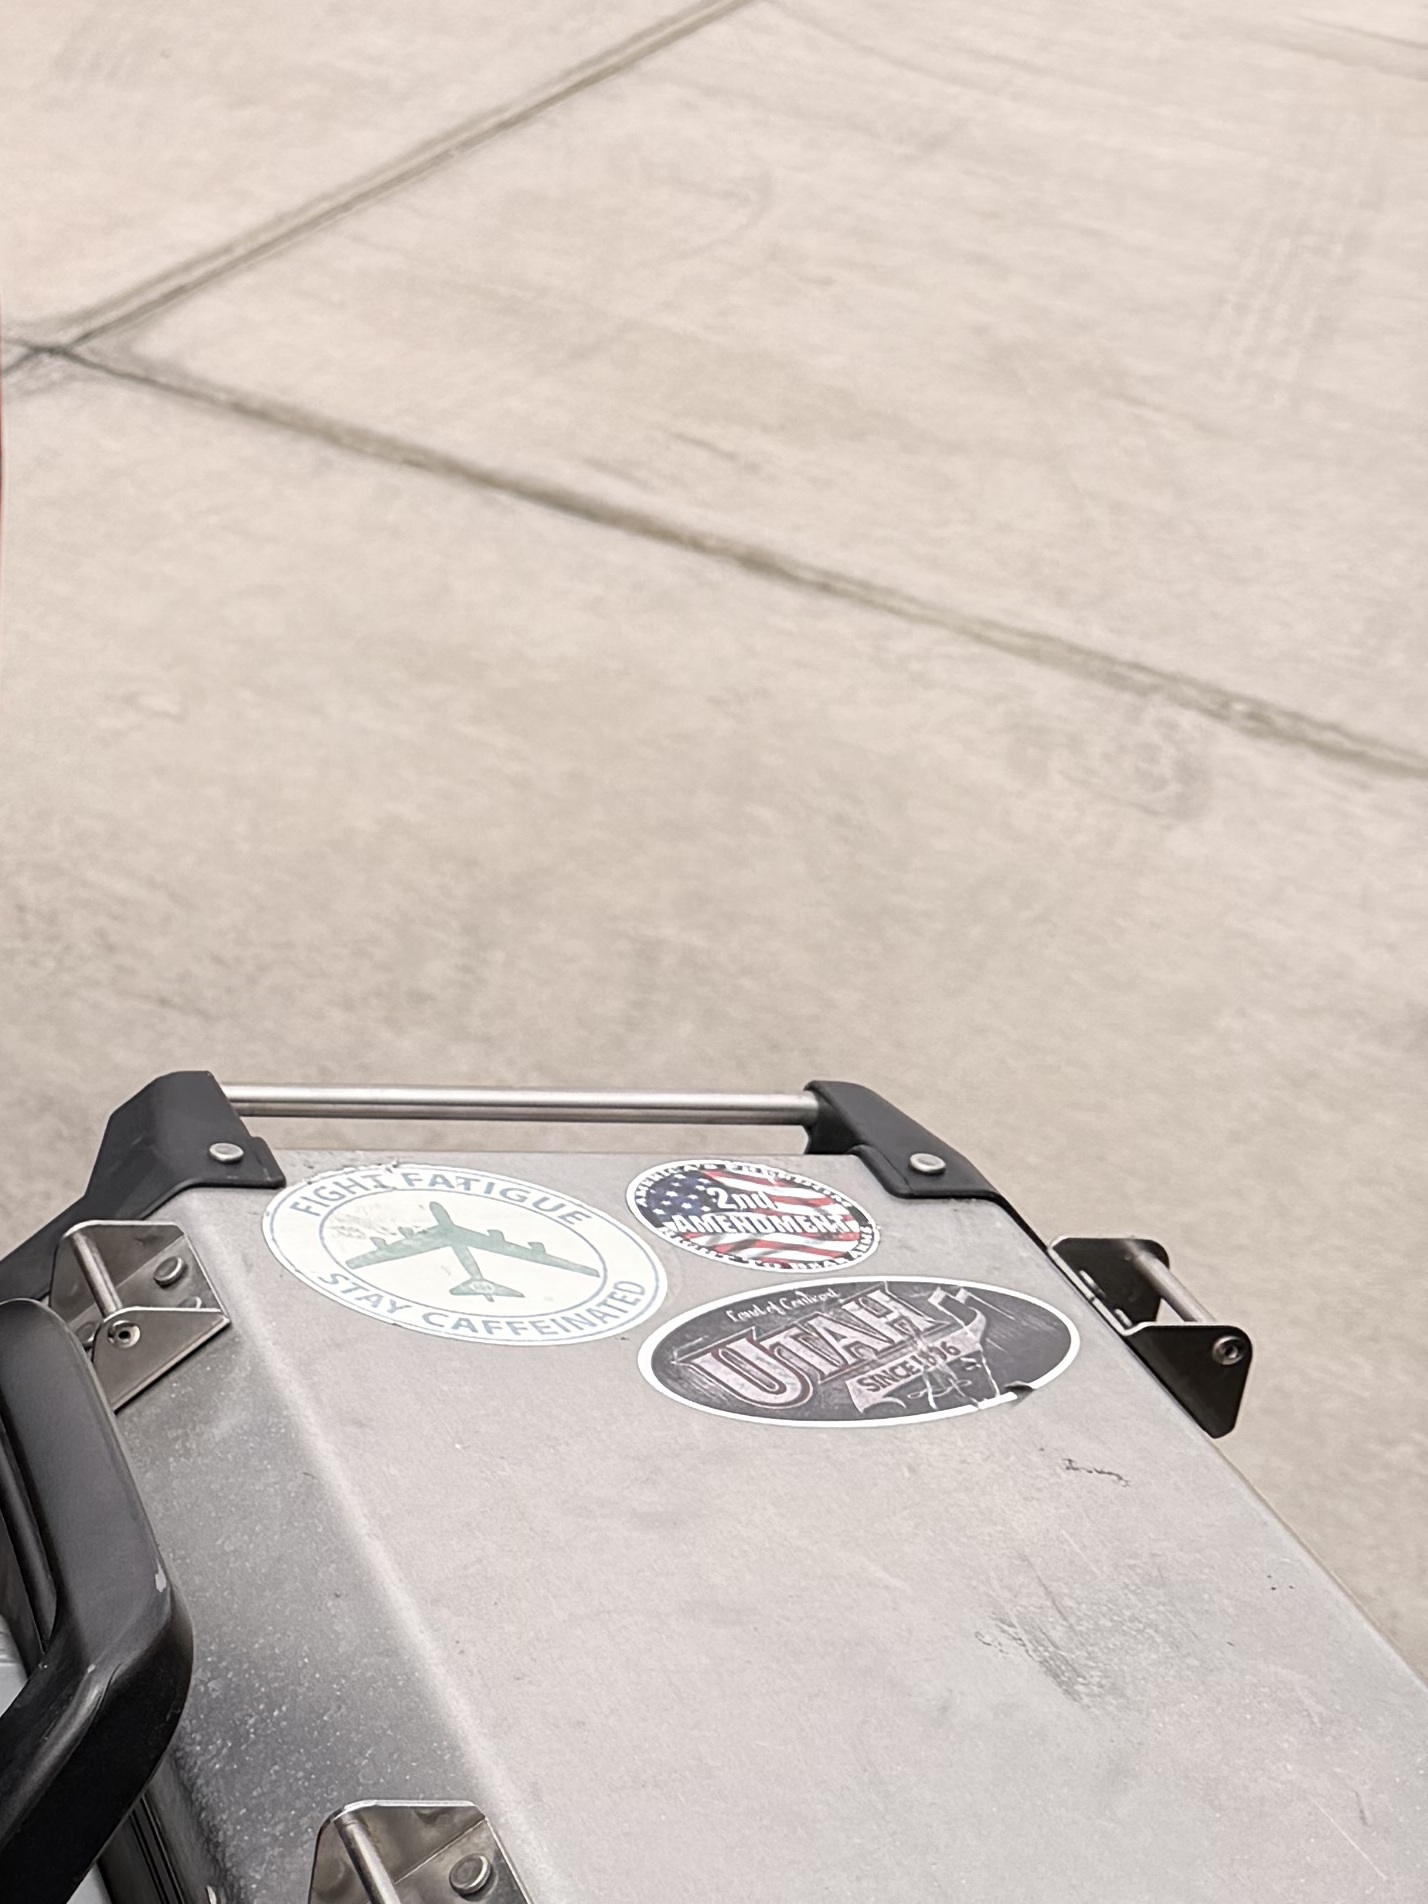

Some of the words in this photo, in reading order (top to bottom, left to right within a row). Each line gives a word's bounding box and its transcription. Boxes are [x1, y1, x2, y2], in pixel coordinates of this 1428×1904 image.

[289, 1172, 393, 1218] FIGHT
[402, 1171, 593, 1227] FATIGUE
[707, 1186, 779, 1211] 2nd
[673, 1212, 851, 1235] AMENDMENT
[317, 1272, 412, 1315] STAY
[421, 1278, 646, 1337] CAFFEINATED
[685, 1286, 941, 1408] UTAH
[856, 1360, 915, 1394] SINCE
